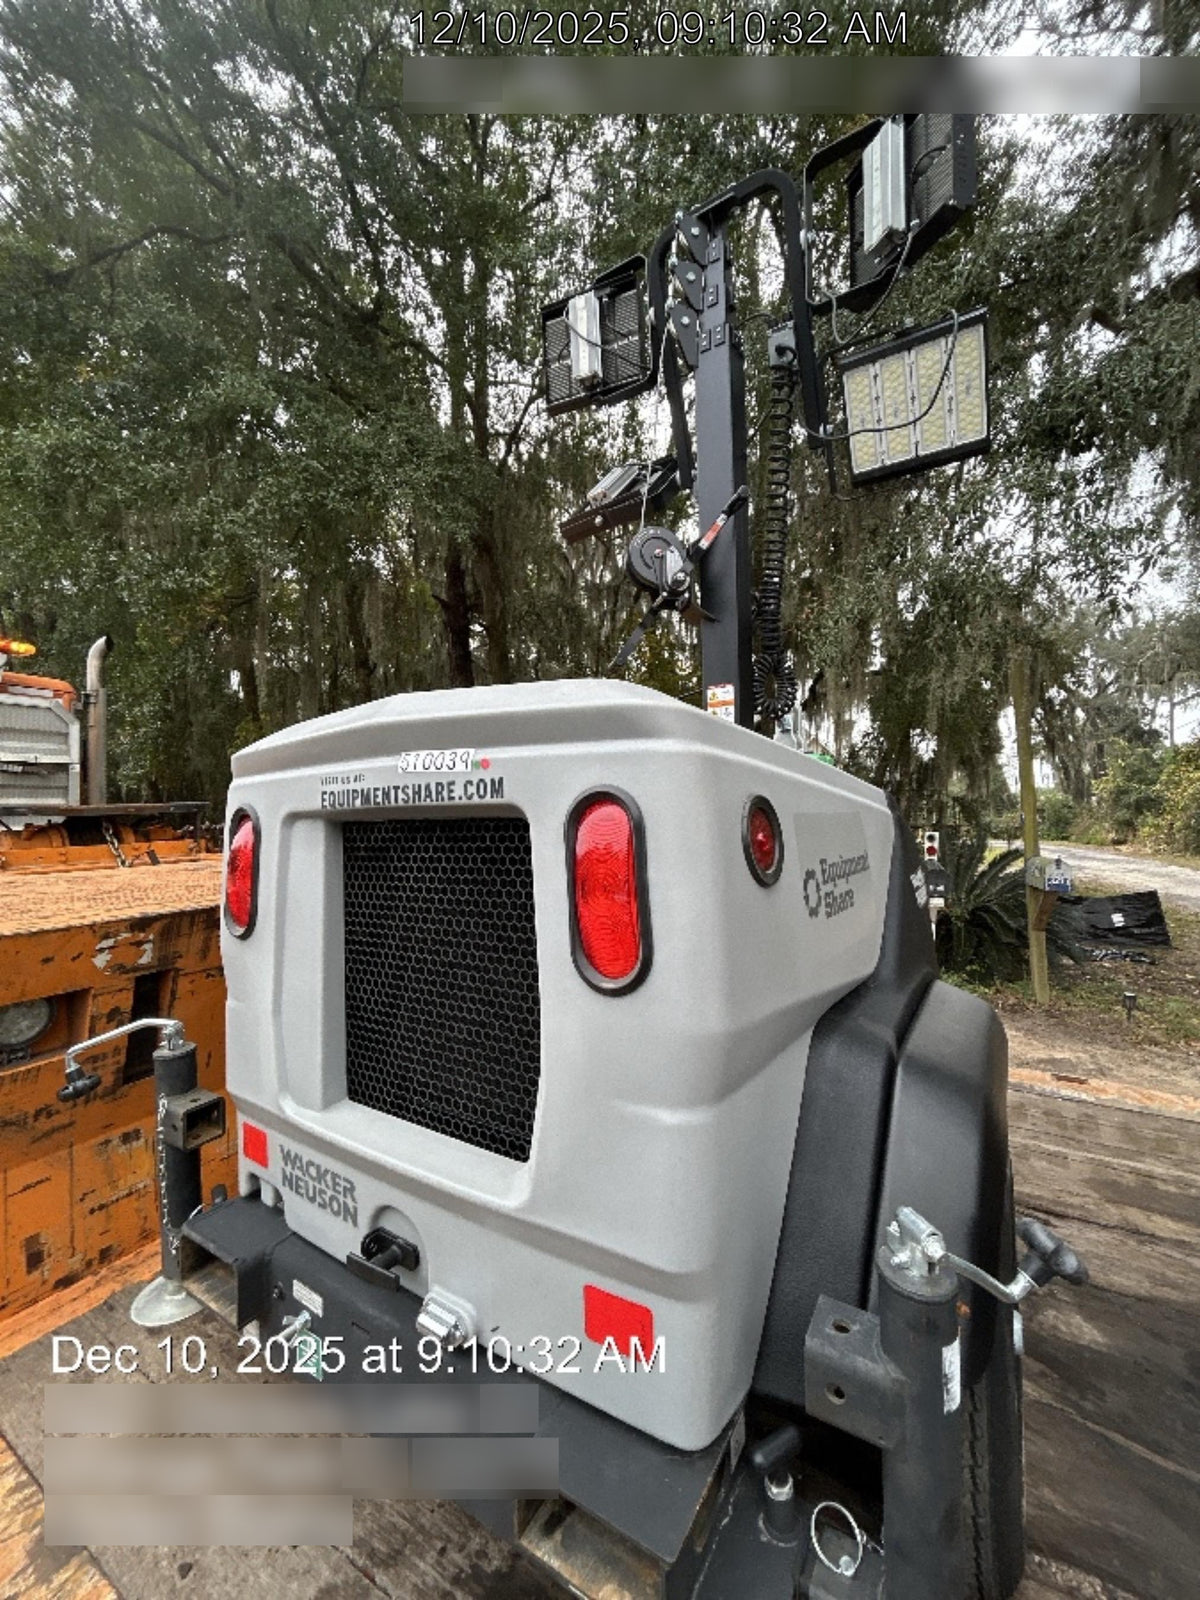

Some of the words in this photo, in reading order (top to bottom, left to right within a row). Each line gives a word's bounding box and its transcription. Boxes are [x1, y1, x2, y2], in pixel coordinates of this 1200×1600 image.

[321, 776, 505, 810] EQUIPMENTSHARE.COM
[279, 1144, 358, 1204] WACKER
[282, 1167, 358, 1228] NEUSON
